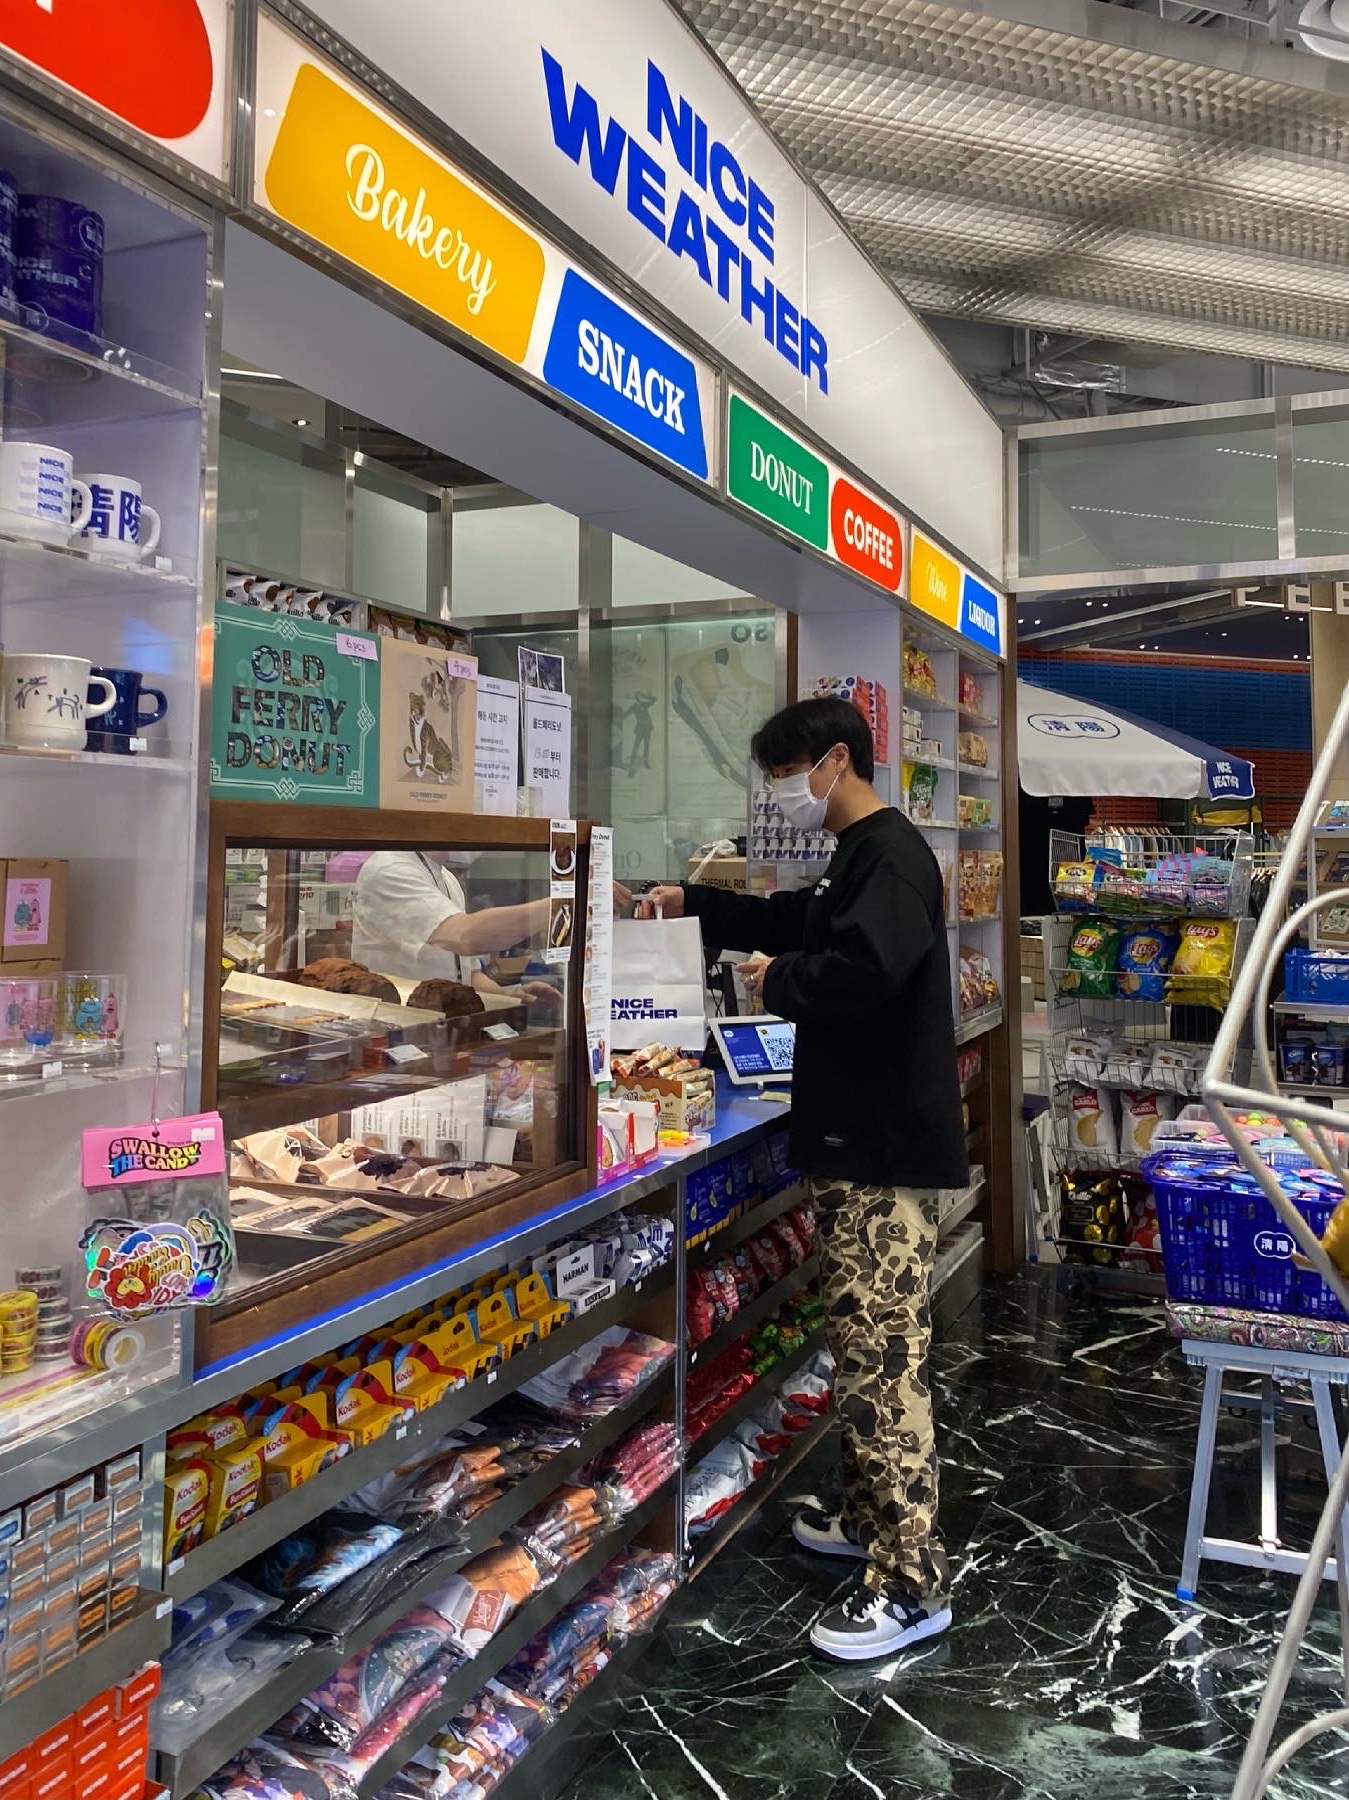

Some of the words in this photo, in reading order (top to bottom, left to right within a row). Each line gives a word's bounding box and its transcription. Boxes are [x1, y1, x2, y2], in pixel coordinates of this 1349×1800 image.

[648, 58, 774, 264] NICE
[345, 143, 497, 314] Bakery
[541, 46, 829, 395] WEATHER
[578, 320, 686, 436] SNACK
[40, 457, 65, 470] NICE
[39, 472, 64, 484] NICE
[751, 441, 813, 514] DONUT
[38, 487, 63, 499] NICE
[37, 502, 62, 514] NICE
[843, 508, 894, 570] COFFEE
[925, 561, 948, 602] Wine
[968, 600, 996, 637] LIQUOR
[251, 645, 326, 688] OLD
[231, 686, 346, 736] FERRY
[226, 731, 351, 777] DONUT
[611, 998, 653, 1009] NICE
[109, 1138, 200, 1159] SWALLOW
[110, 1152, 143, 1178] THE
[563, 1263, 589, 1284] HARMAN
[396, 1364, 417, 1384] Kodak
[337, 1397, 361, 1417] Kodak
[265, 1432, 292, 1454] Kodak
[228, 1460, 255, 1482] Kodak
[176, 1477, 203, 1502] Kodak
